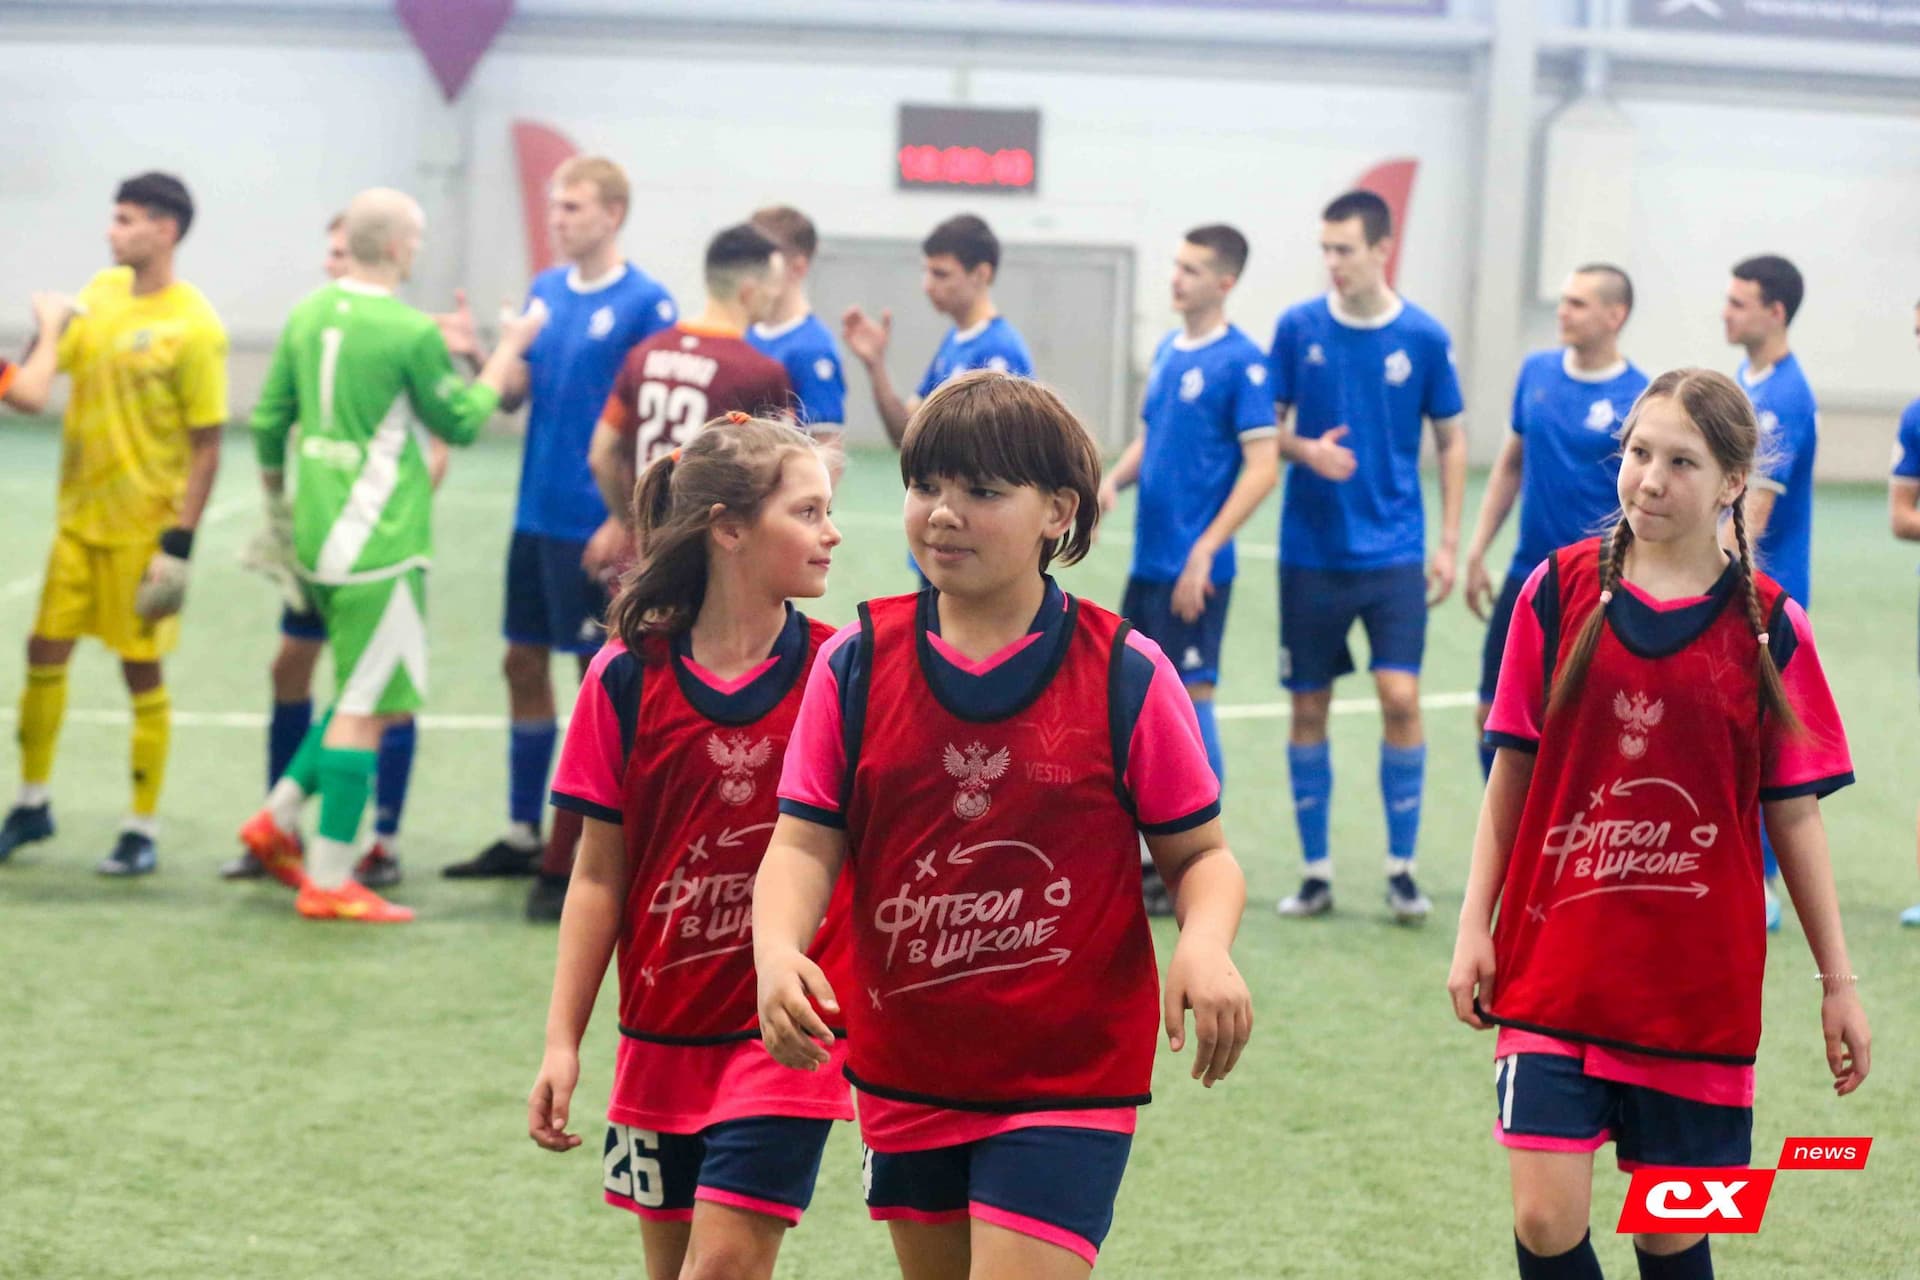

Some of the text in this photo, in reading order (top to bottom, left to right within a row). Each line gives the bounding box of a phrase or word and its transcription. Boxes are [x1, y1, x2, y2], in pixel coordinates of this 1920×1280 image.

[320, 327, 344, 428] 1
[635, 380, 708, 478] 23
[1543, 812, 1671, 886] ФУТБОЛ
[1593, 852, 1700, 880] ШКОЛЕ
[875, 882, 1023, 972] ФУТБОЛ
[930, 916, 1060, 968] ШКОЛЕ
[603, 1124, 664, 1207] 26
